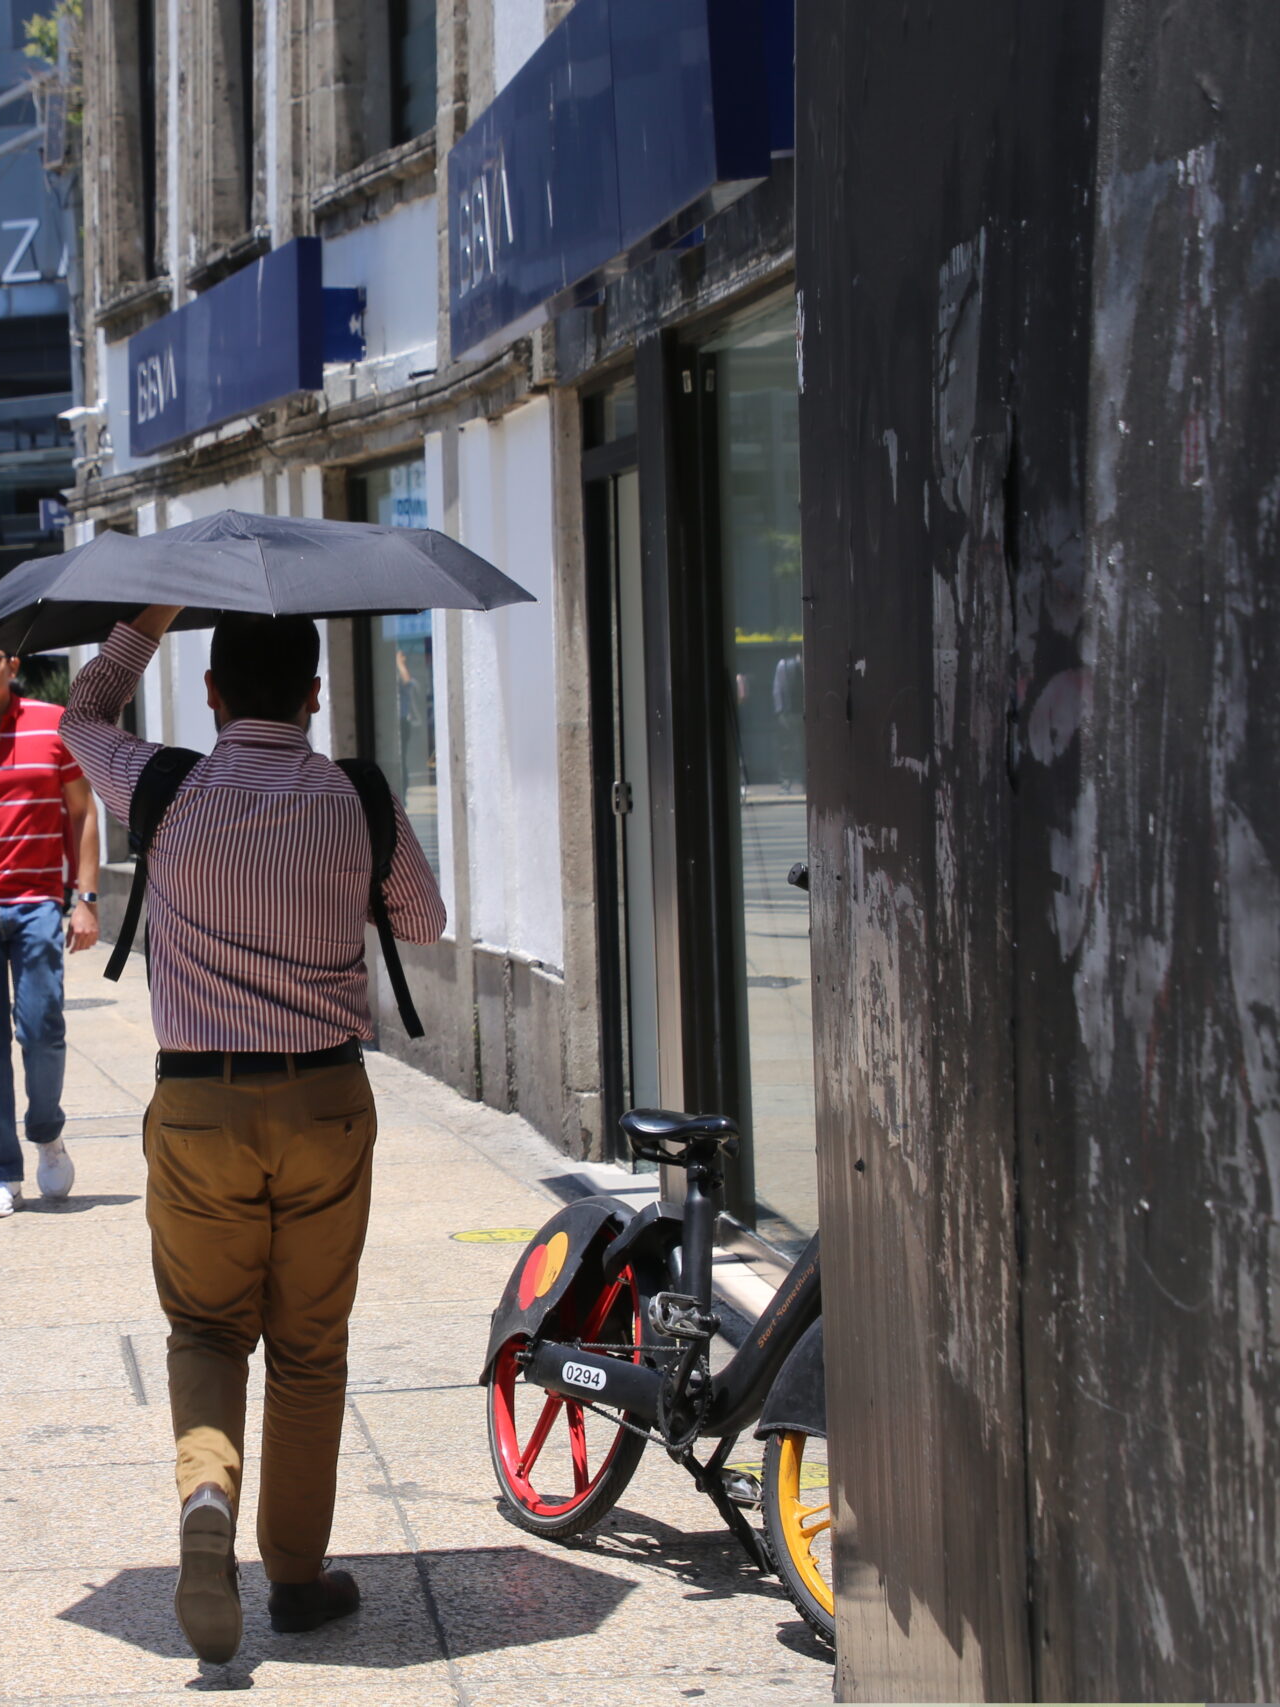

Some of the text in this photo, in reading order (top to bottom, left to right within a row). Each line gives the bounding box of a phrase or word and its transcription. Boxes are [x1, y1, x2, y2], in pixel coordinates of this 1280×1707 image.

[458, 141, 514, 299] BBVA
[136, 344, 178, 424] BBVA
[757, 1263, 816, 1349] Start Something
[566, 1365, 600, 1387] 0294
